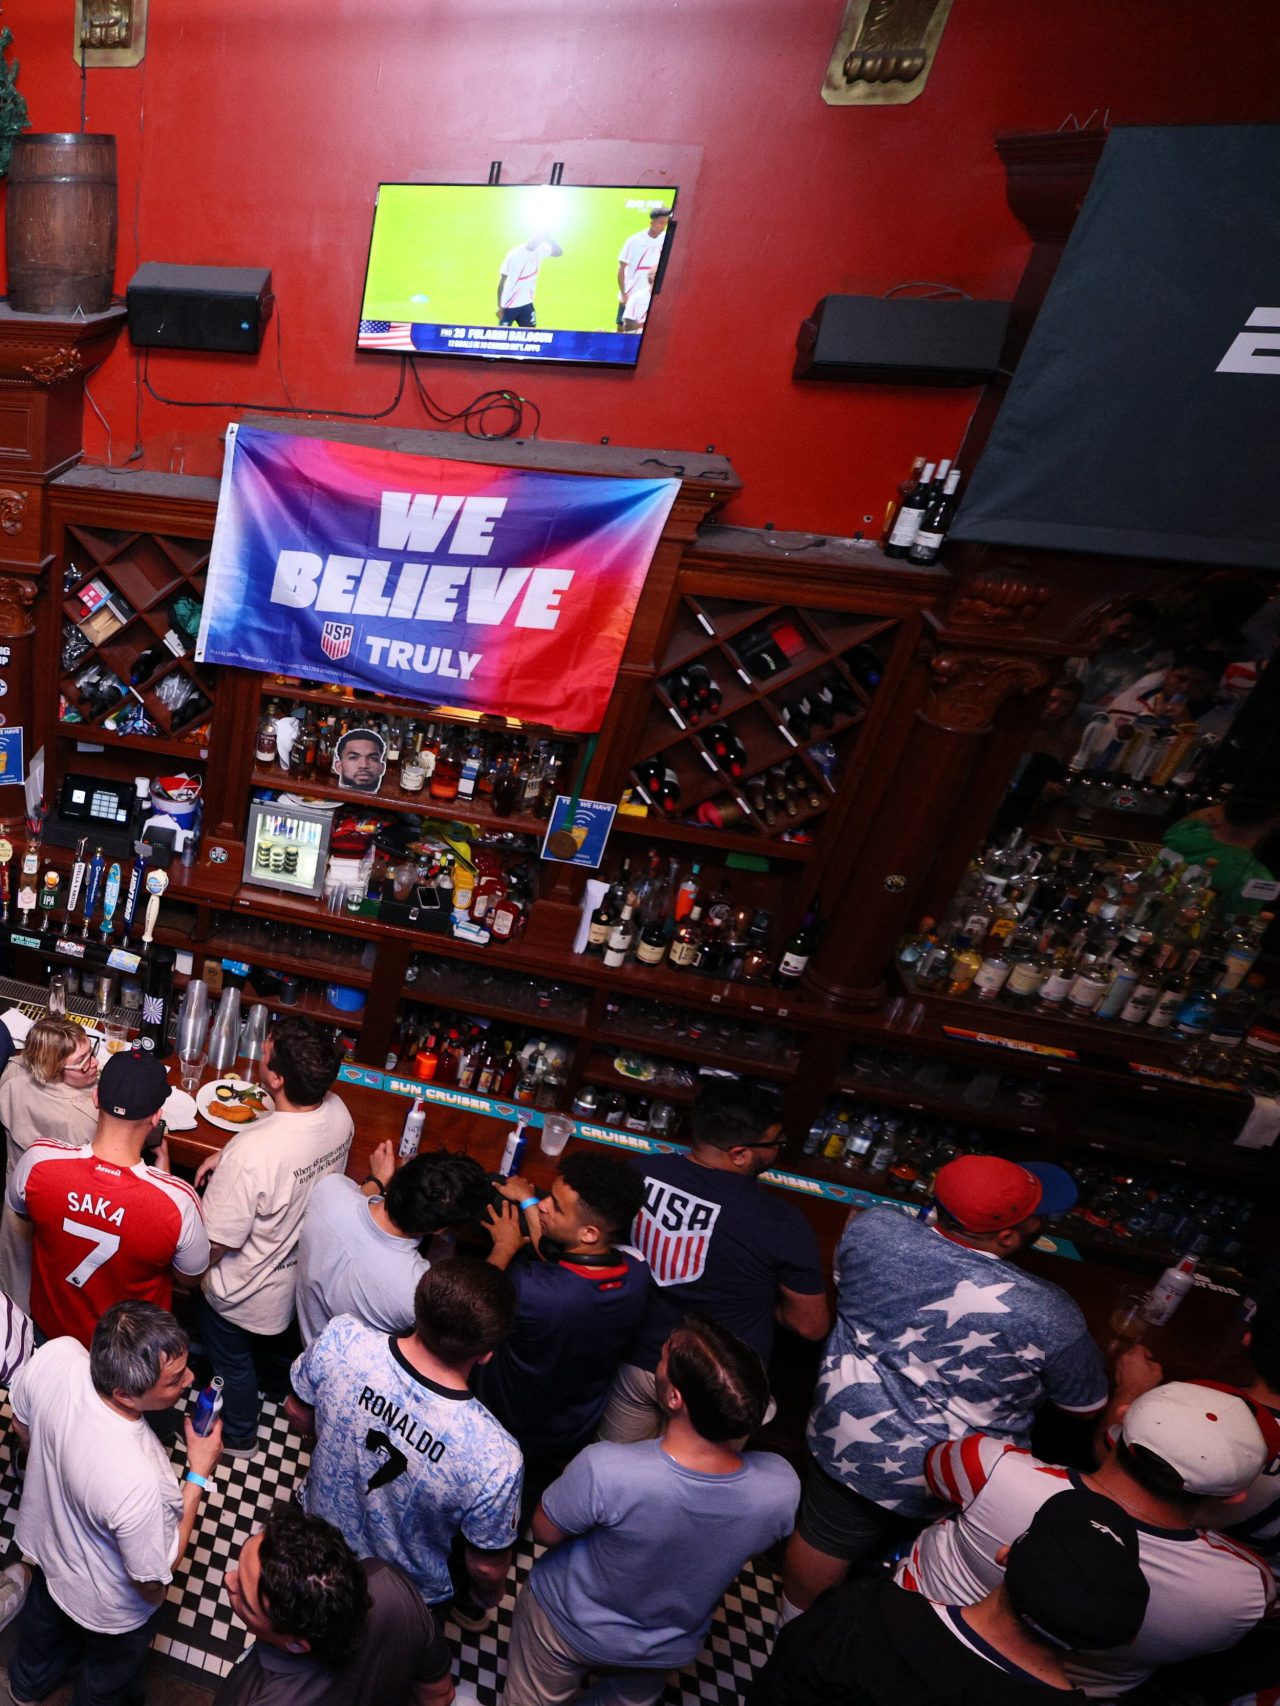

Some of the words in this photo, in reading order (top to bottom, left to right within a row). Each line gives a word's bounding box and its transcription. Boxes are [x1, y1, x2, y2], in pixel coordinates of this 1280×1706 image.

[468, 328, 508, 341] FOLARIN
[378, 491, 508, 556] WE
[270, 550, 575, 631] BELIEVE
[325, 622, 351, 641] USA
[366, 635, 483, 681] TRULY
[592, 803, 613, 812] HAVE
[128, 868, 140, 899] LIGHT
[43, 894, 55, 906] IPA
[124, 898, 134, 921] BUD
[390, 1080, 422, 1097] SUN
[425, 1087, 493, 1113] CRUISER
[581, 1124, 651, 1151] CRUISER
[94, 1163, 122, 1178] Arsenal
[293, 1164, 311, 1180] Where
[67, 1191, 126, 1228] SAKA
[644, 1182, 715, 1232] USA
[62, 1217, 120, 1289] 7
[1194, 1280, 1241, 1297] orona
[358, 1385, 446, 1464] RONALDO
[365, 1427, 409, 1494] 7
